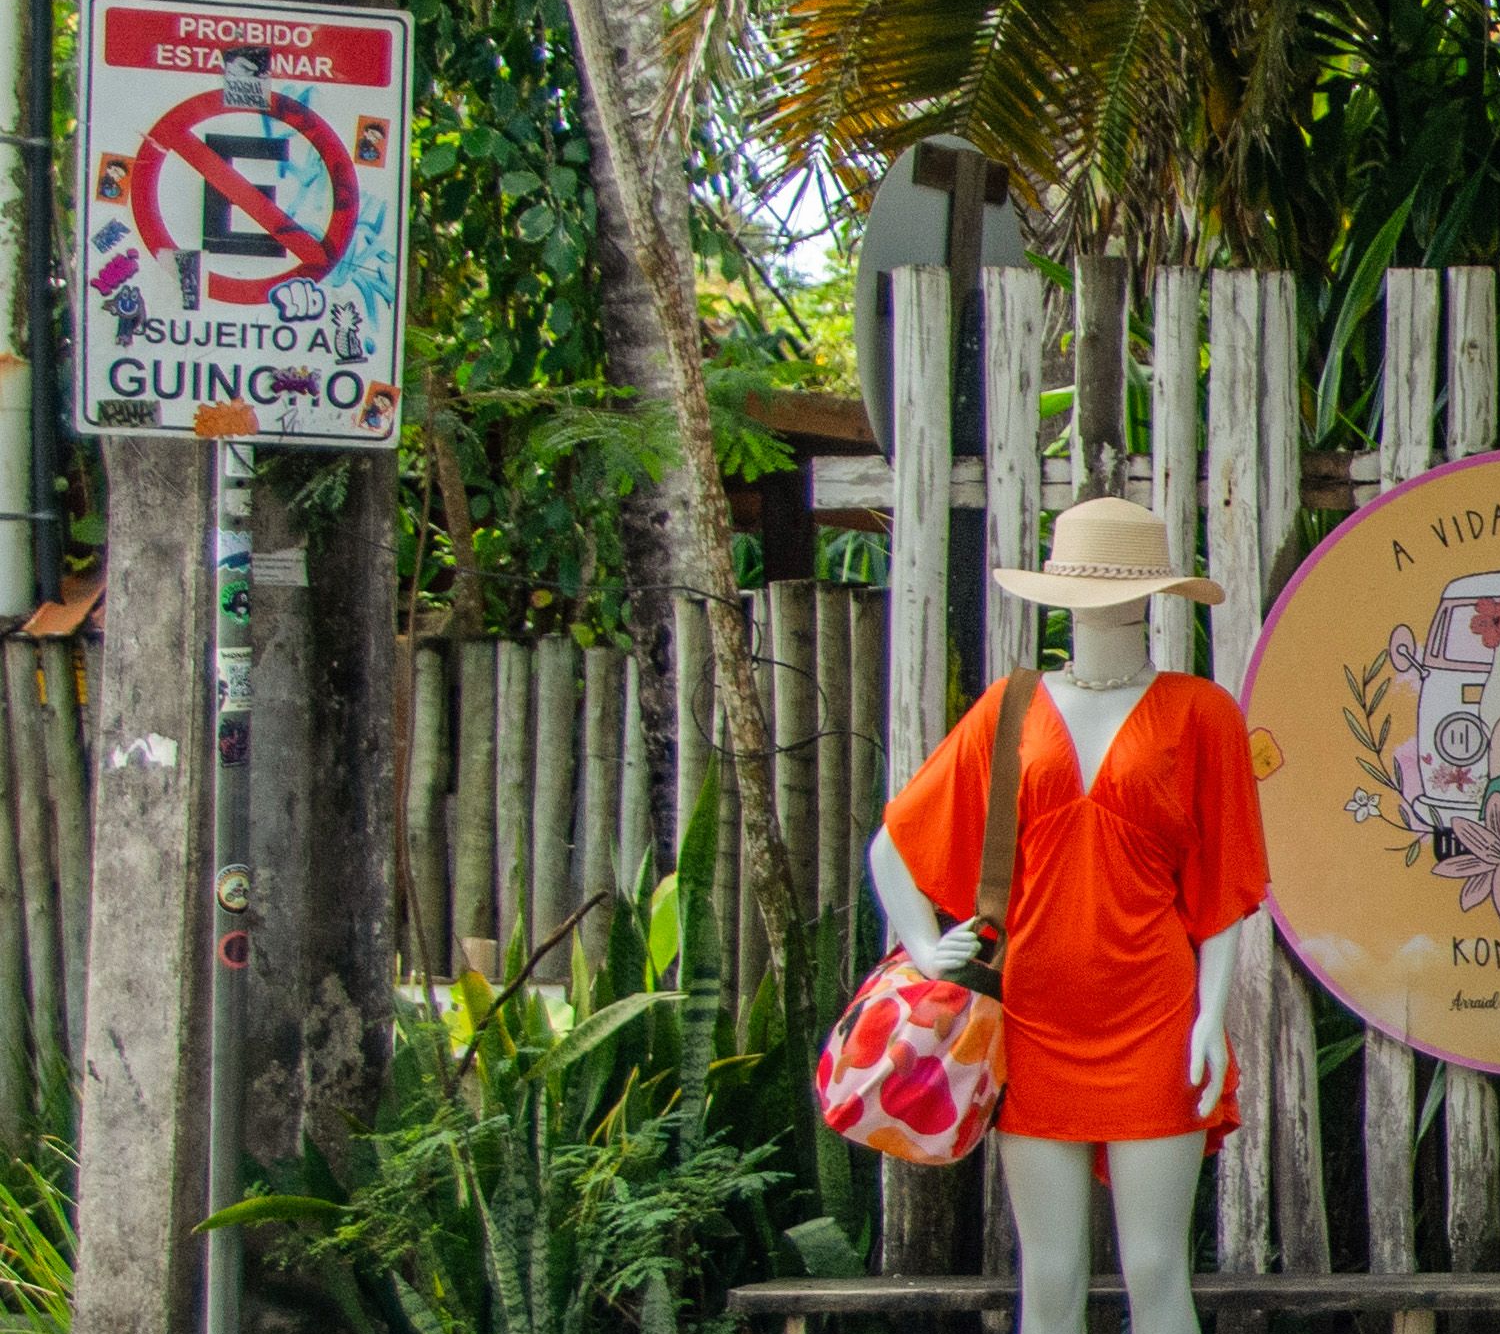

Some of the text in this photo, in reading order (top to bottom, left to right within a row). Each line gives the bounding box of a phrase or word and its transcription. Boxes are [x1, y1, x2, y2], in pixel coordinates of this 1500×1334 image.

[179, 17, 313, 48] PROIBIDO
[156, 44, 333, 78] ESTANAR
[144, 318, 332, 354] SUJEITO A
[109, 357, 365, 409] GUINCO
[1392, 539, 1415, 571] A
[1449, 989, 1500, 1011] Arraial
